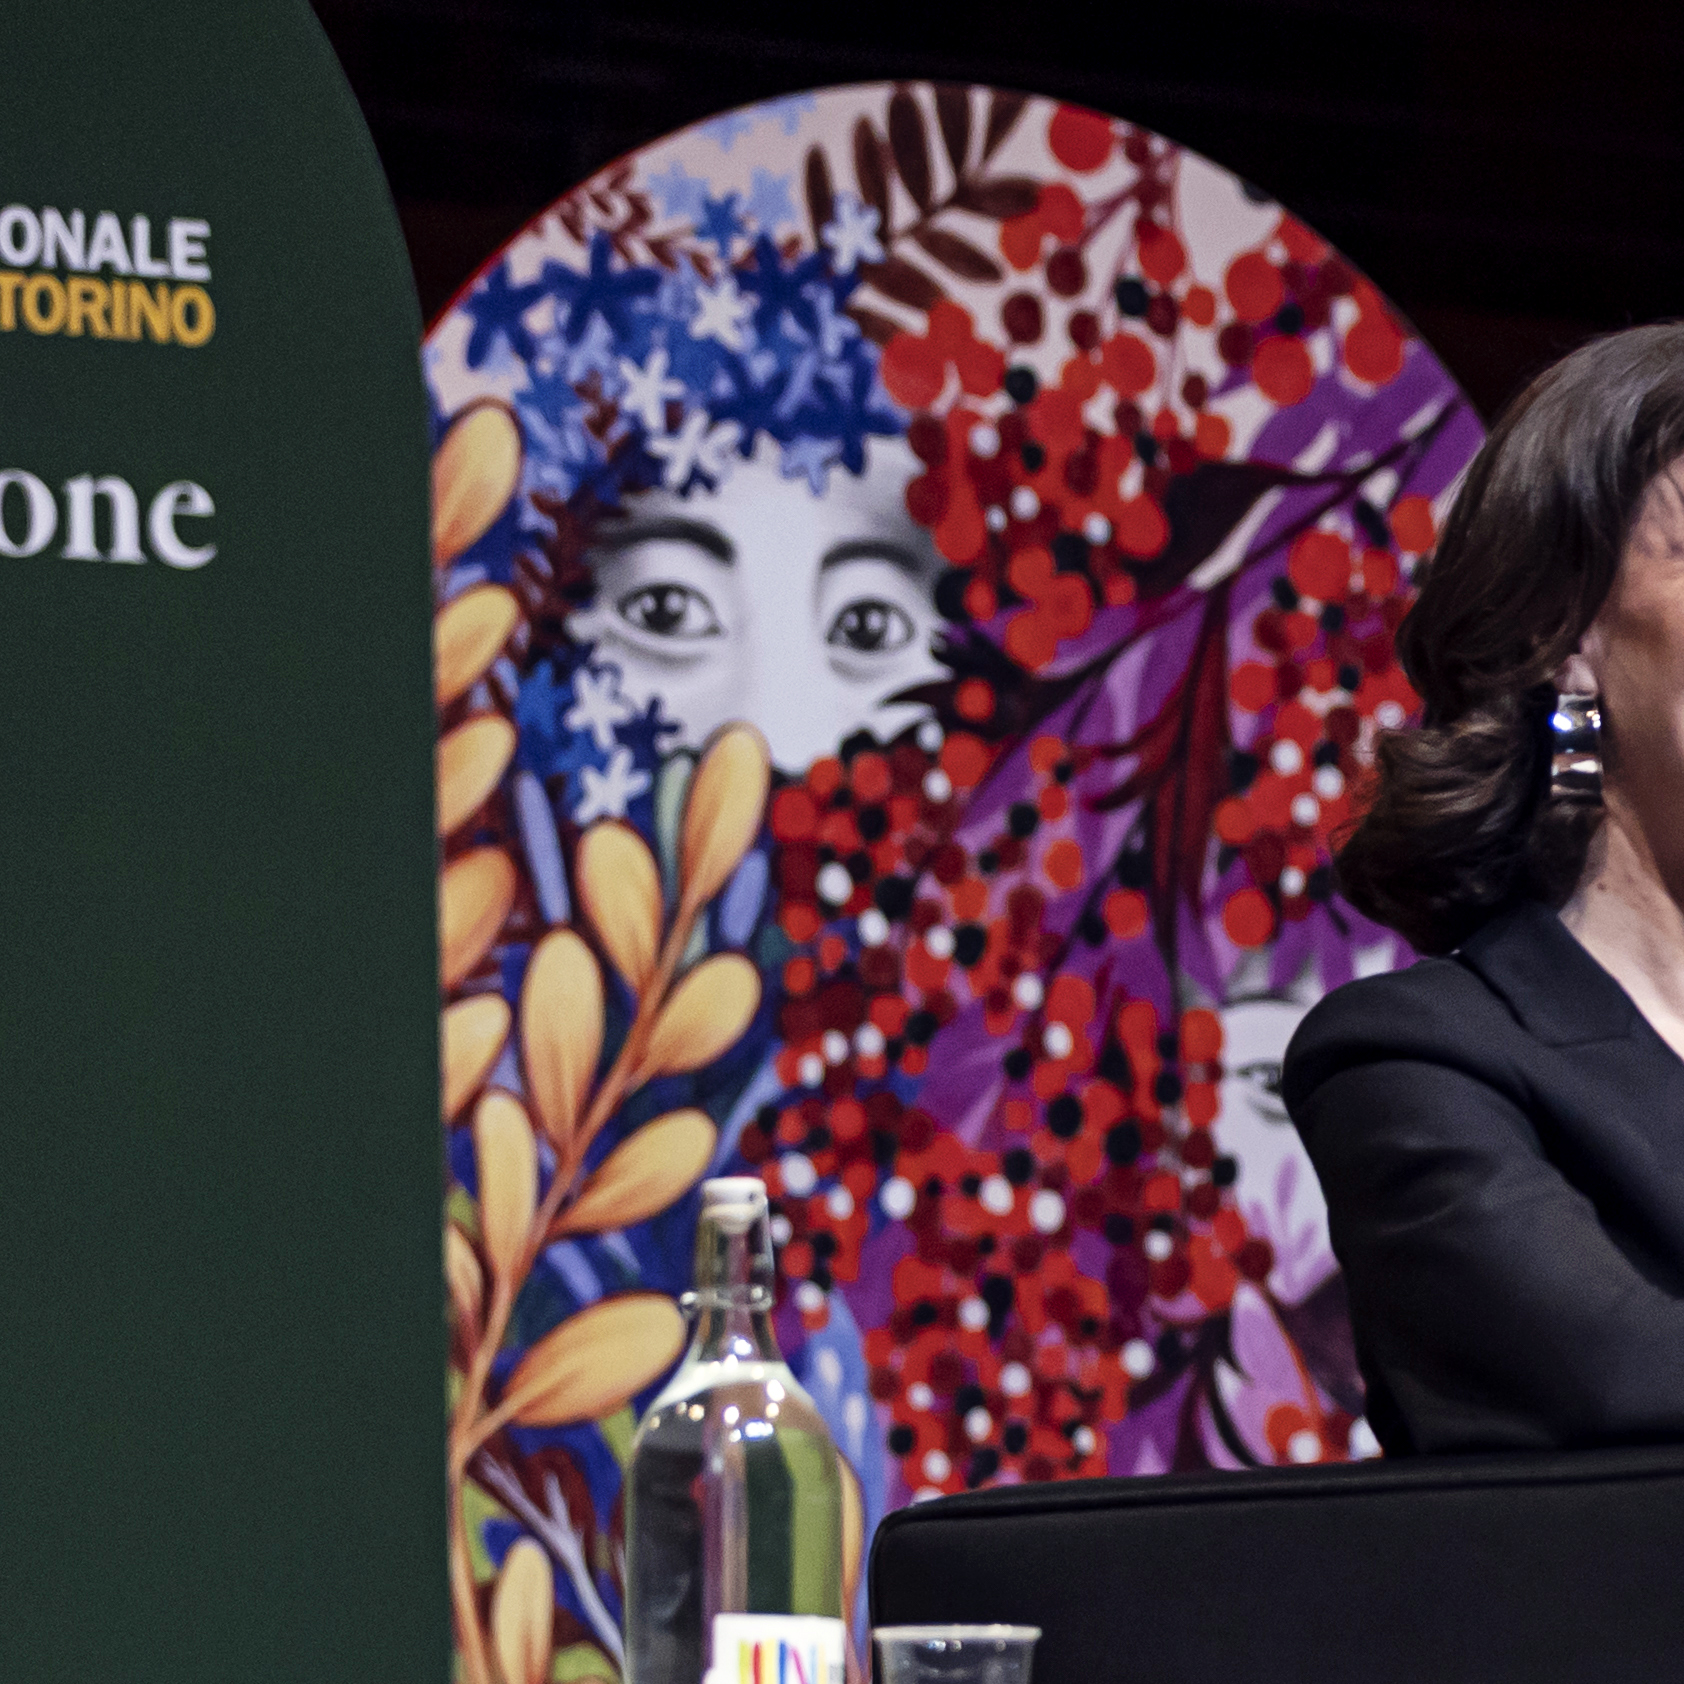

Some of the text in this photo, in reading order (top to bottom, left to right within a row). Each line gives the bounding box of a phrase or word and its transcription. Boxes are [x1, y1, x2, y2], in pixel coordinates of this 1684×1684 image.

[0, 204, 212, 282] ONALE
[0, 270, 216, 348] TORINO
[0, 467, 217, 570] one
